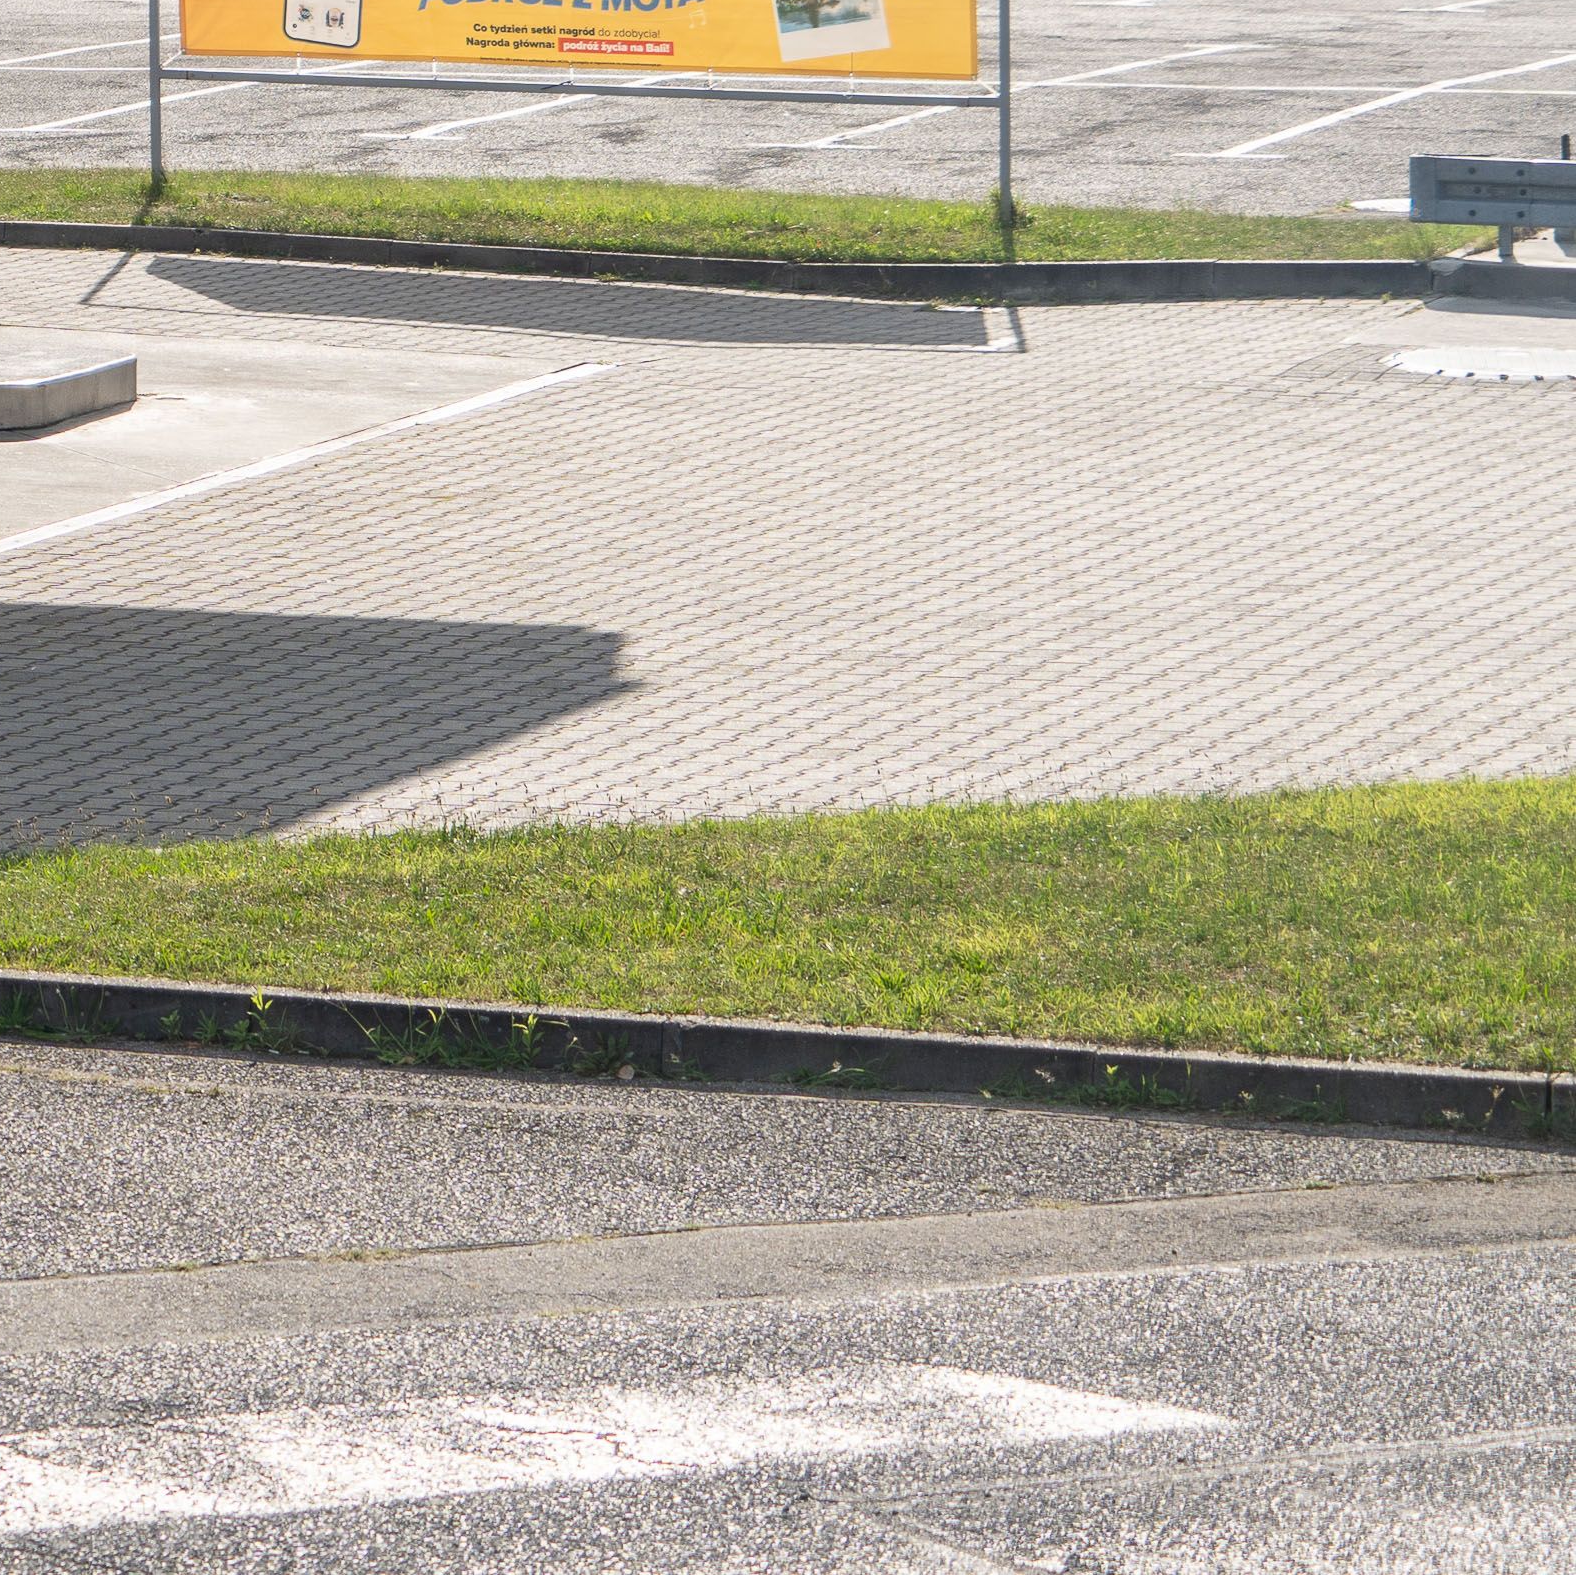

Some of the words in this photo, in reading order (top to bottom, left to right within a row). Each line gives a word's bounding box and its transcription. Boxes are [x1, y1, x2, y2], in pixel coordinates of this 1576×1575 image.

[473, 24, 488, 32] Co
[490, 25, 528, 35] tydzień
[531, 26, 557, 35] setki
[559, 27, 595, 38] nagród
[598, 27, 611, 38] do
[613, 28, 661, 40] zdobycia!
[465, 37, 510, 49] Nagroda
[513, 38, 556, 50] główna:
[563, 39, 600, 53] podróż
[601, 42, 628, 53] życia
[630, 45, 644, 53] na
[645, 43, 670, 54] Bali!
